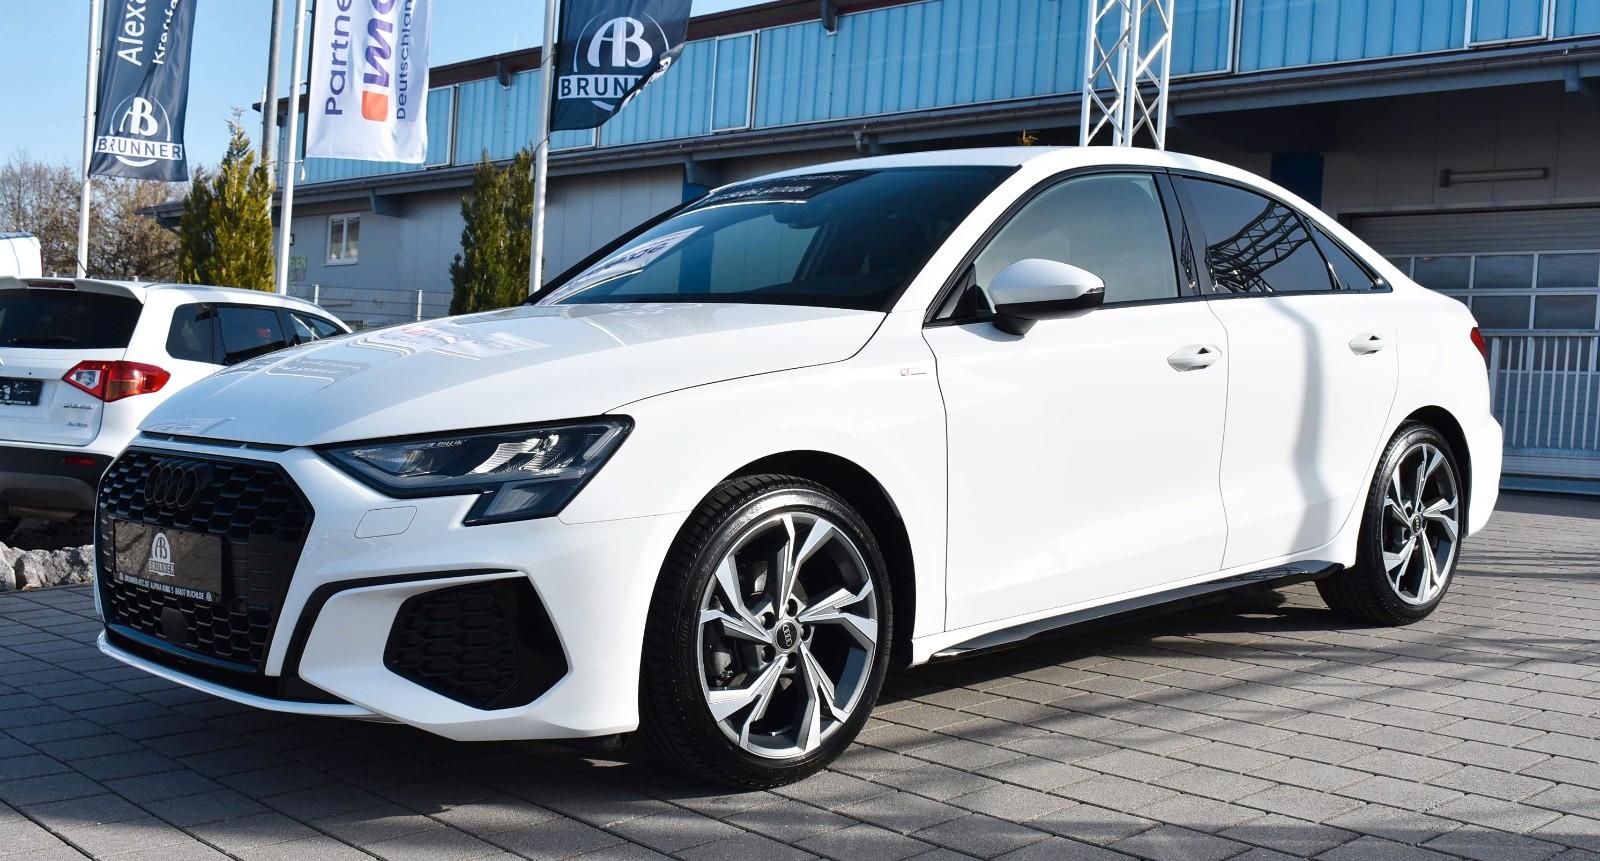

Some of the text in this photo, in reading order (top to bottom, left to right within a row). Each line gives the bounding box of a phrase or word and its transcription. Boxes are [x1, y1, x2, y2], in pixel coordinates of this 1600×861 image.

[118, 0, 146, 66] Alex
[561, 77, 641, 97] BRUN
[97, 137, 182, 159] BRUNNER
[148, 560, 175, 574] BRUNNER
